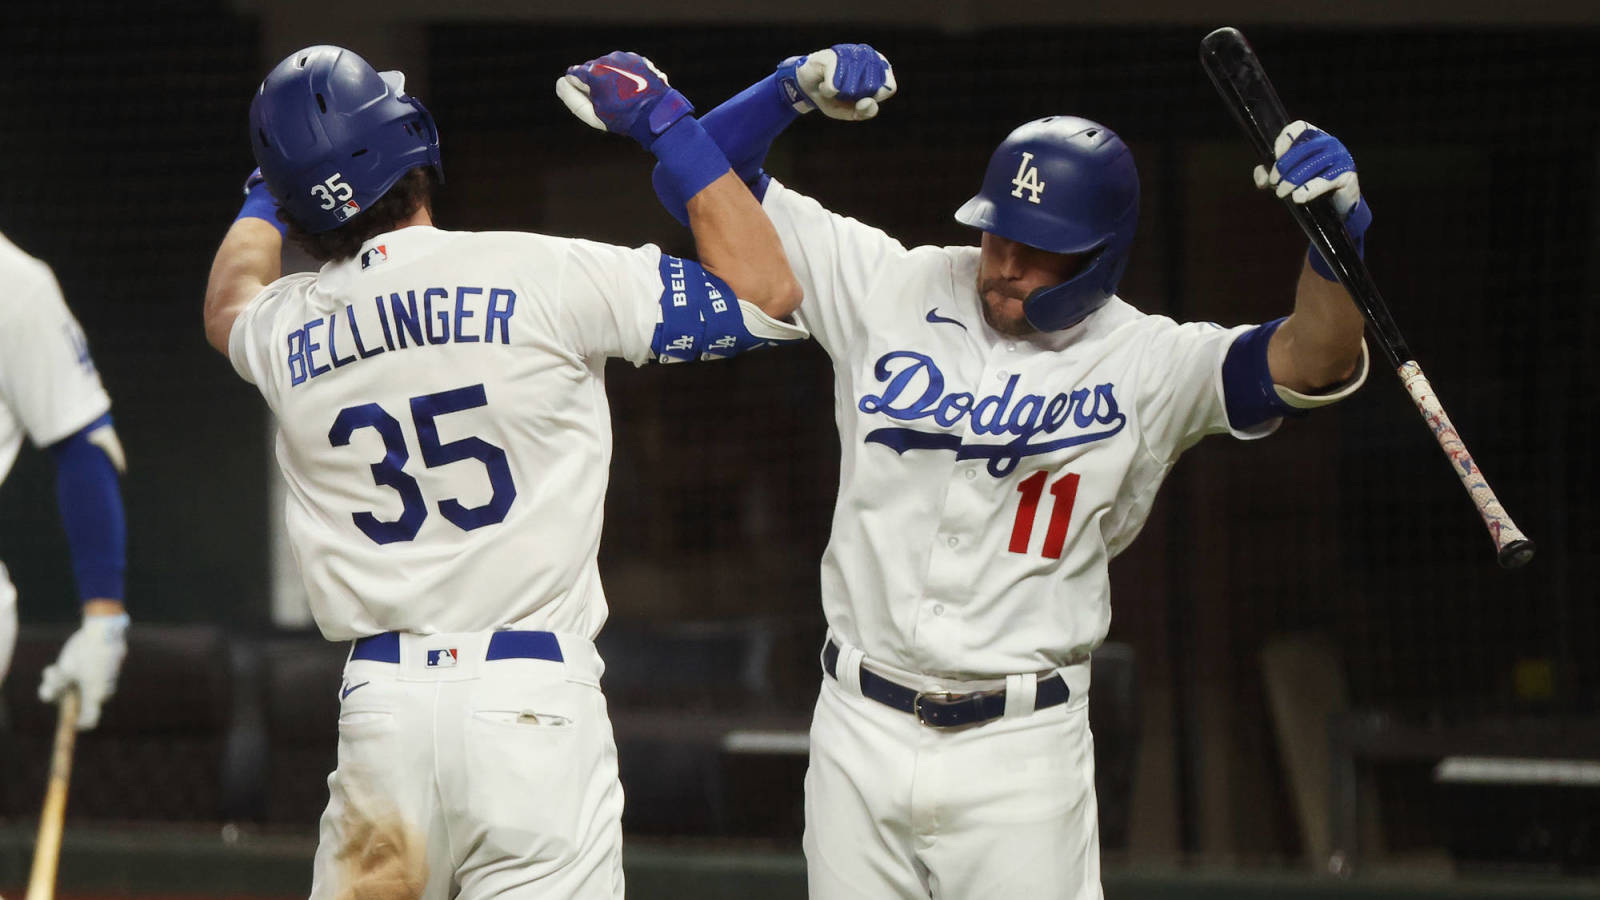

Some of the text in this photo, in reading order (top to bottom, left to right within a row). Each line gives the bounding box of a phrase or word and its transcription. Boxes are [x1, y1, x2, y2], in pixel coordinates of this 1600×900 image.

[311, 172, 353, 211] 35
[1011, 151, 1045, 204] LA
[288, 286, 517, 387] BELLINGER
[858, 350, 1126, 479] Dodgers
[328, 383, 517, 545] 35
[1008, 470, 1080, 560] 11
